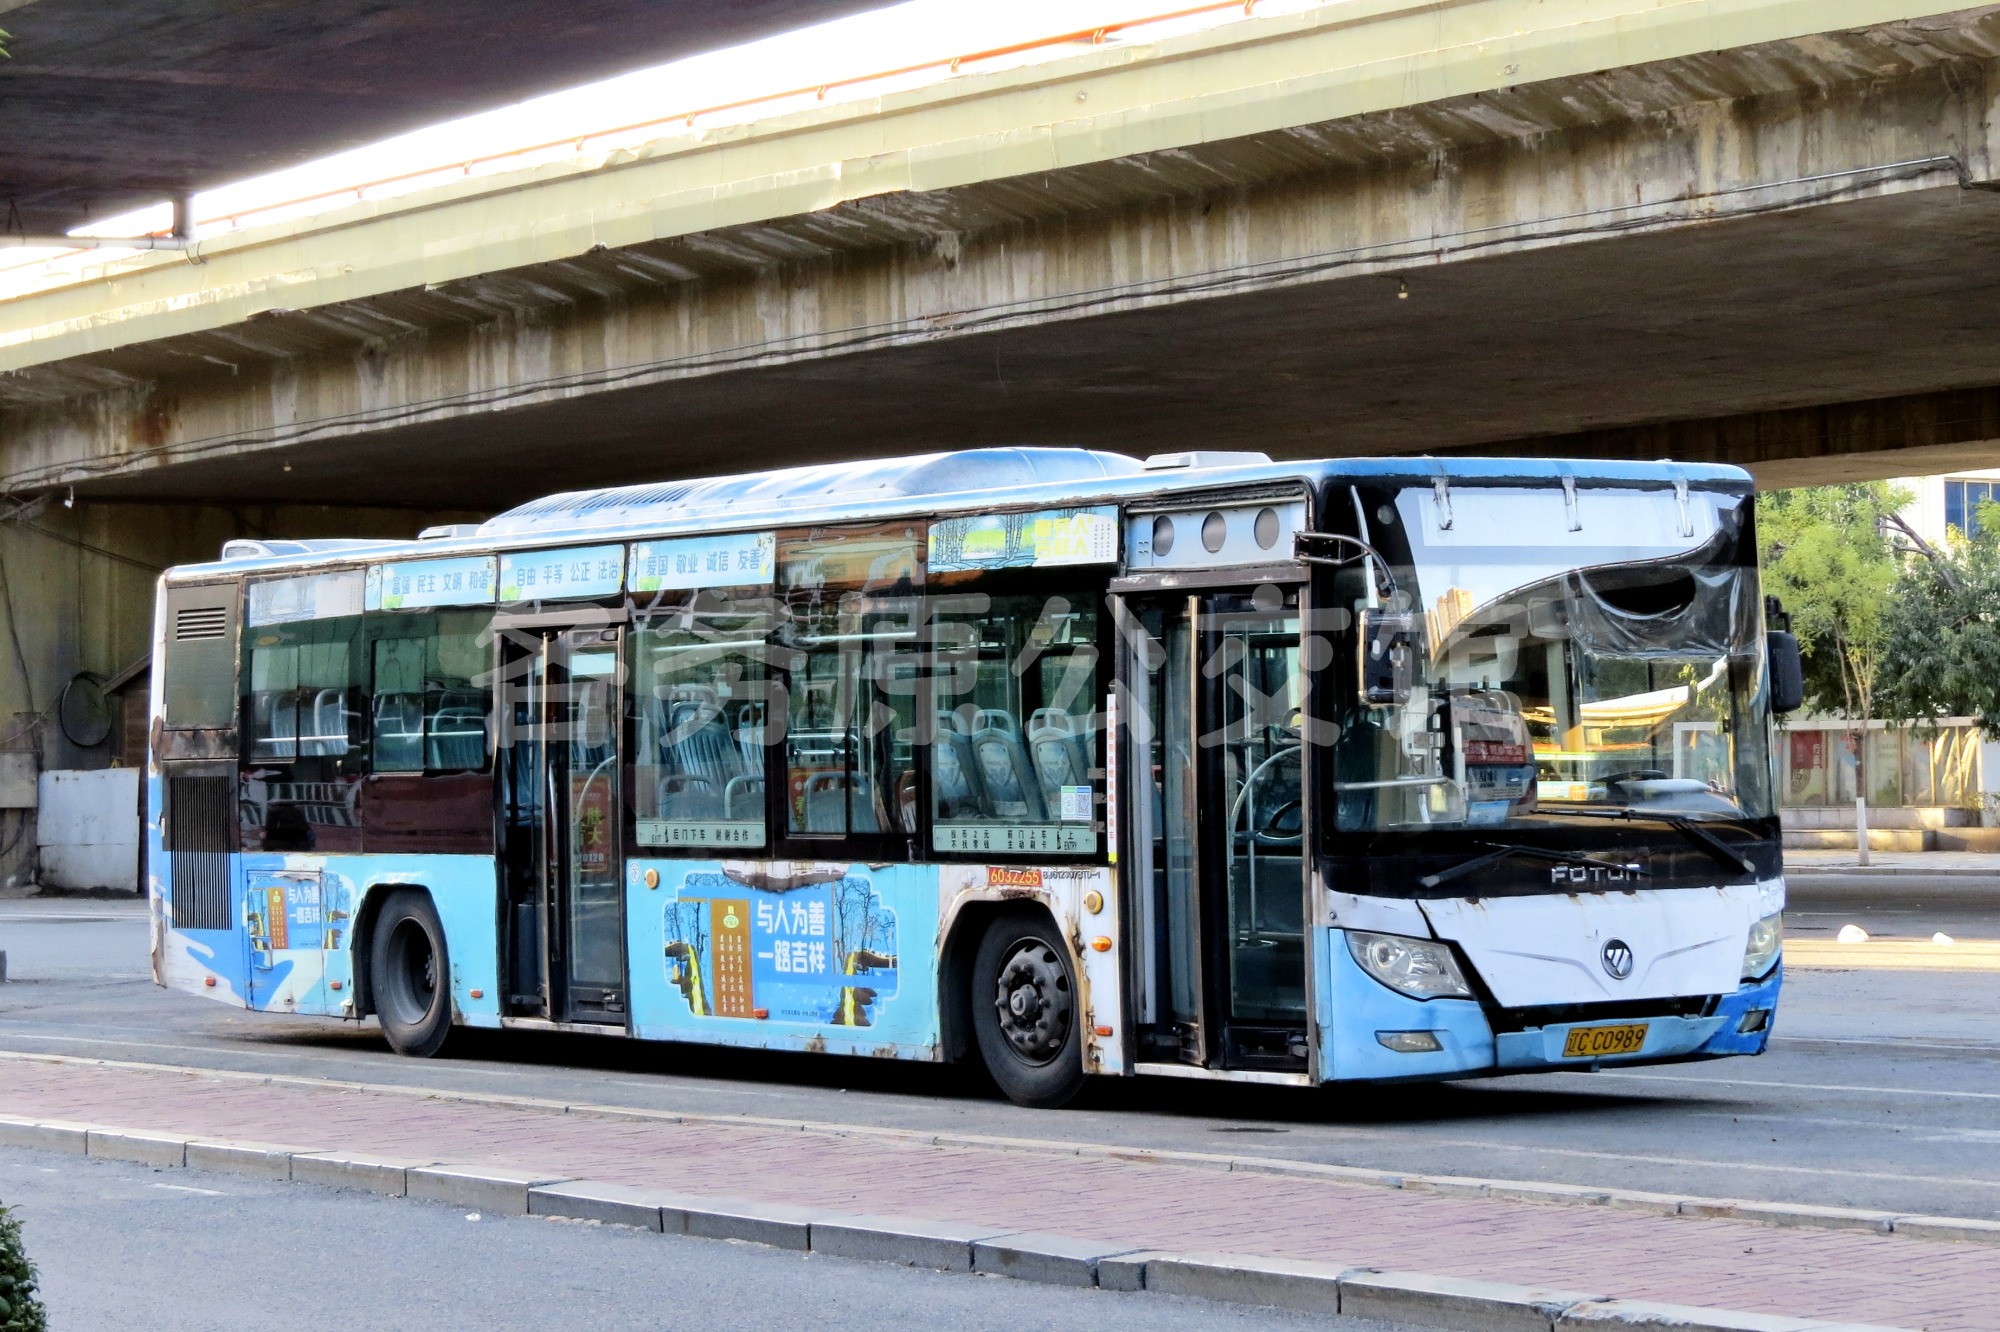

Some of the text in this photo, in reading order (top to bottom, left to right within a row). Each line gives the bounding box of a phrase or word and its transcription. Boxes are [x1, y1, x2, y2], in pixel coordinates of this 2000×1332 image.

[516, 560, 618, 586] 自由 平等 公正 法治
[647, 548, 761, 577] 爱国 敬业 诚信 友善
[392, 570, 490, 595] 富强 民主 文明 和谐
[673, 828, 749, 842] 后门下车 谢谢合作
[951, 829, 1047, 840] 投币2元 前门上车
[990, 868, 1039, 884] 6032255
[758, 899, 826, 936] 与人为善
[758, 940, 826, 974] 一路吉祥
